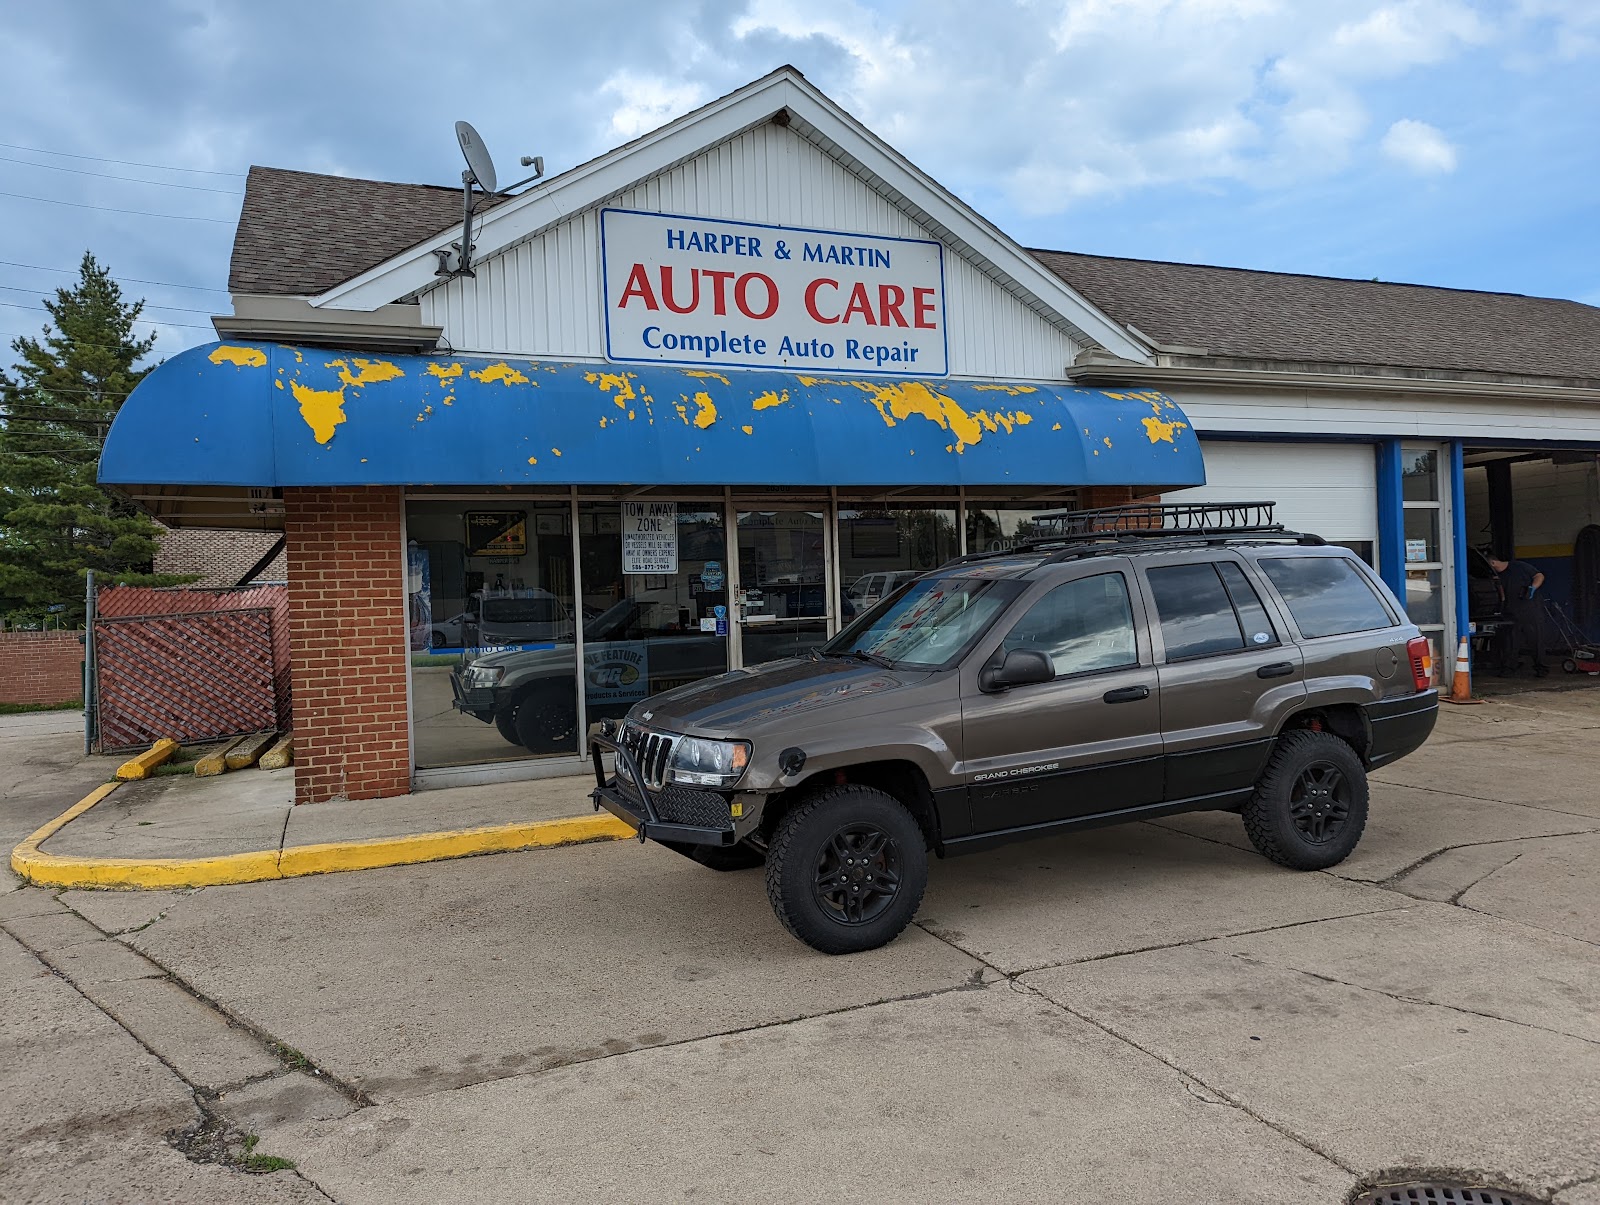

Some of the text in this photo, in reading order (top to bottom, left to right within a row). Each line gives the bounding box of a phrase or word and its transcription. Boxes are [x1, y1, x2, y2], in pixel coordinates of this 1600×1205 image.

[666, 228, 891, 269] HARPER & MARTIN
[617, 263, 937, 330] AUTO CARE
[642, 326, 919, 366] Complete Auto Repair
[624, 502, 674, 517] TOW AWAY
[637, 517, 663, 532] ZONE
[624, 533, 675, 541] UNAUTHORIZED VEHICLES
[631, 541, 647, 549] VESSELS
[647, 541, 656, 549] WILL
[663, 541, 675, 549] TOWED
[642, 549, 657, 557] OWNERS
[658, 549, 675, 557] EXPENSE
[468, 644, 519, 654] AUTO CARE
[600, 649, 644, 665] FEATURE
[585, 691, 612, 700] roducts
[618, 690, 646, 698] Services
[973, 762, 1060, 781] GRAND CHEROKEE
